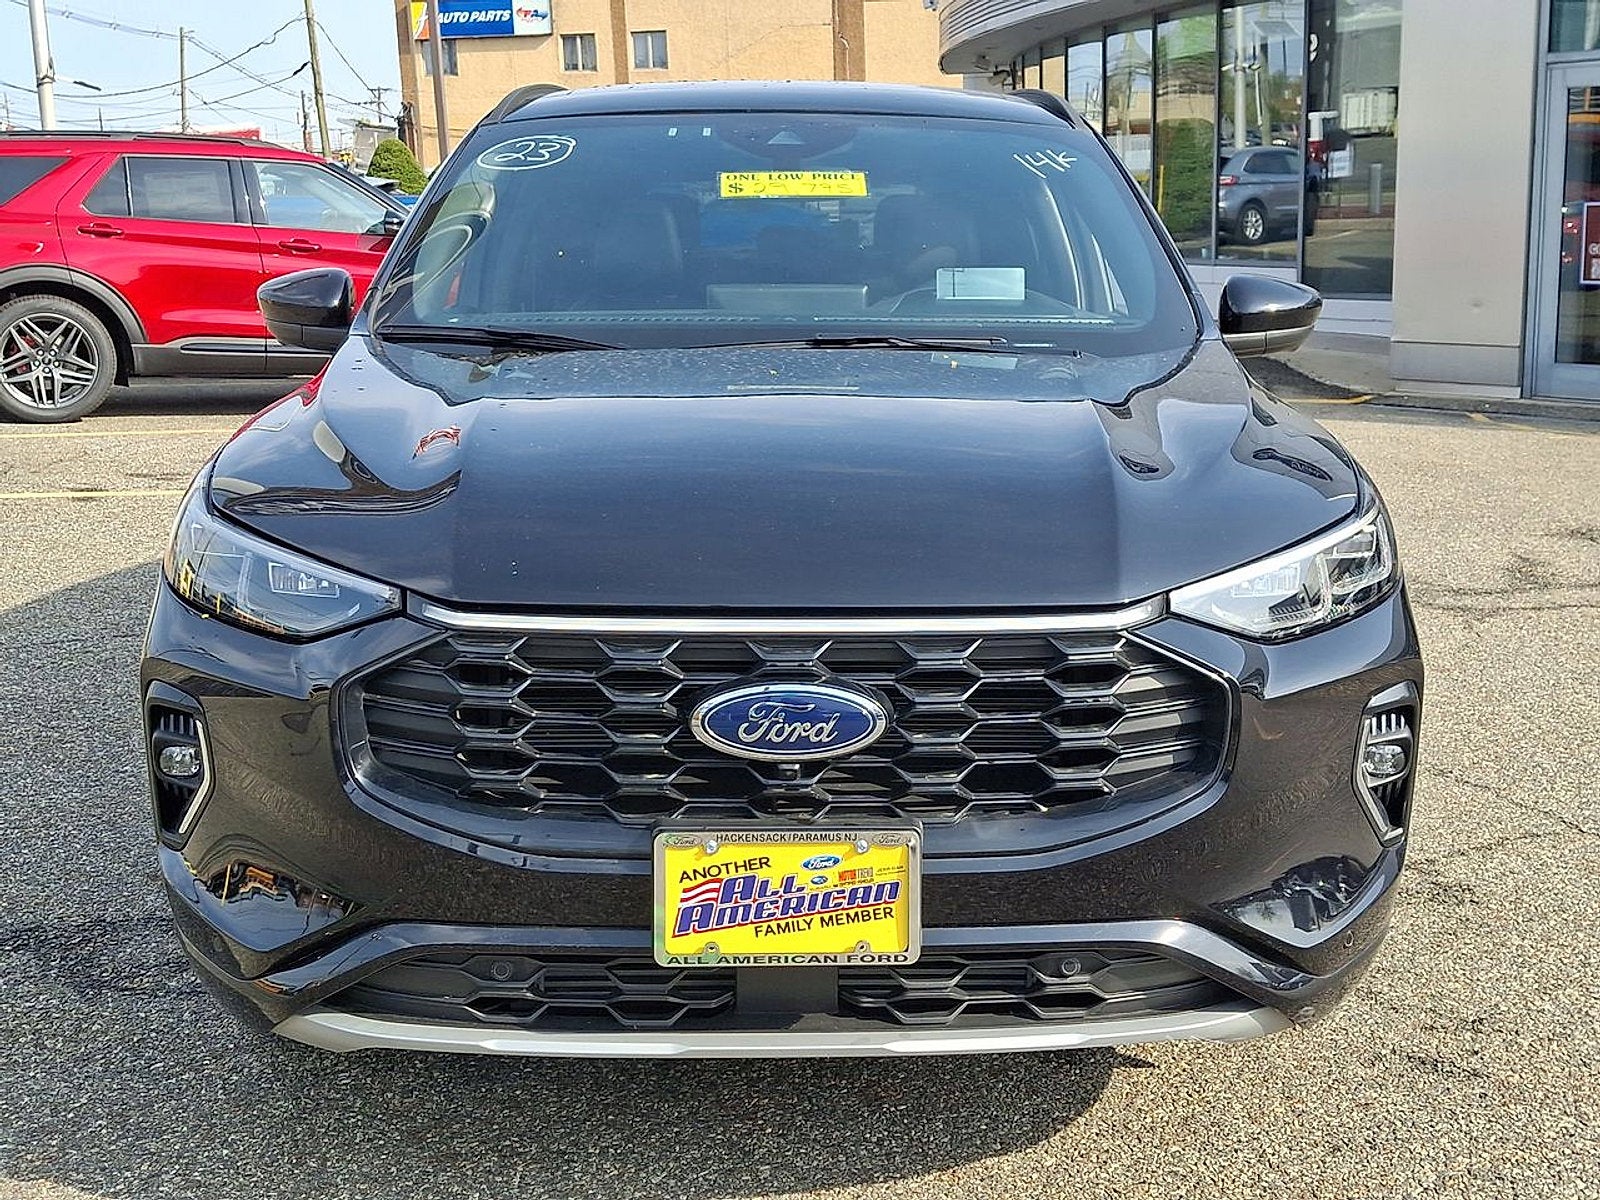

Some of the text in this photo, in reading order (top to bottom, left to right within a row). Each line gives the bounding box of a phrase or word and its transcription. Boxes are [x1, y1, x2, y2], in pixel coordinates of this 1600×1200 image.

[438, 10, 511, 24] AUTO PARTS
[494, 141, 561, 161] 23
[726, 173, 760, 181] ONE
[738, 702, 840, 743] Ford
[844, 833, 858, 842] NJ
[808, 855, 837, 869] Ford
[679, 857, 771, 883] ANOTHER
[754, 907, 895, 938] FAMILY MEMBER
[667, 953, 909, 965] ALL AMERICAN FORD
